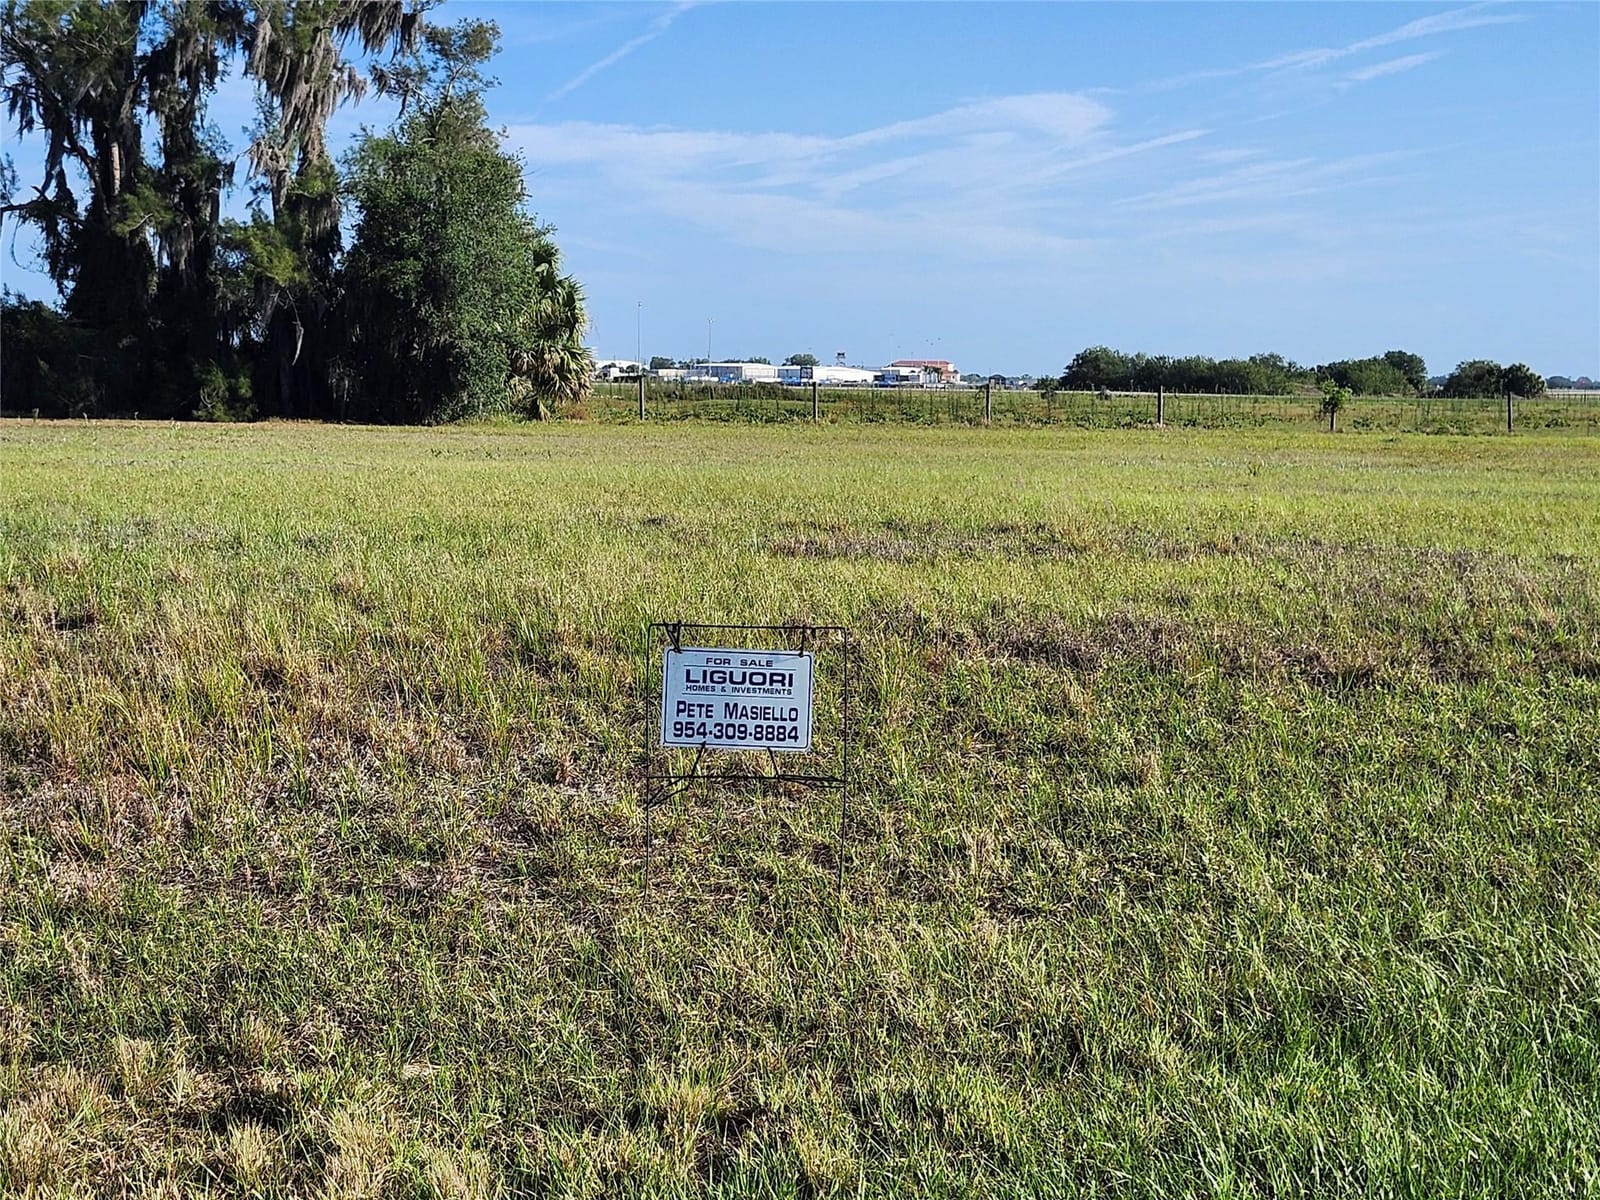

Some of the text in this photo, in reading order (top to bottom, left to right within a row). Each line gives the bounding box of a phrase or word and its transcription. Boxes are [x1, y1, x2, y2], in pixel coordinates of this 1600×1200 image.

[705, 657, 774, 668] FOR SALE
[685, 669, 794, 688] LIGUORI
[685, 684, 716, 693] HOMES
[731, 687, 792, 696] INVESTMENTS
[676, 700, 799, 722] PETE MASIELLO
[673, 721, 799, 743] 954-309-8884
